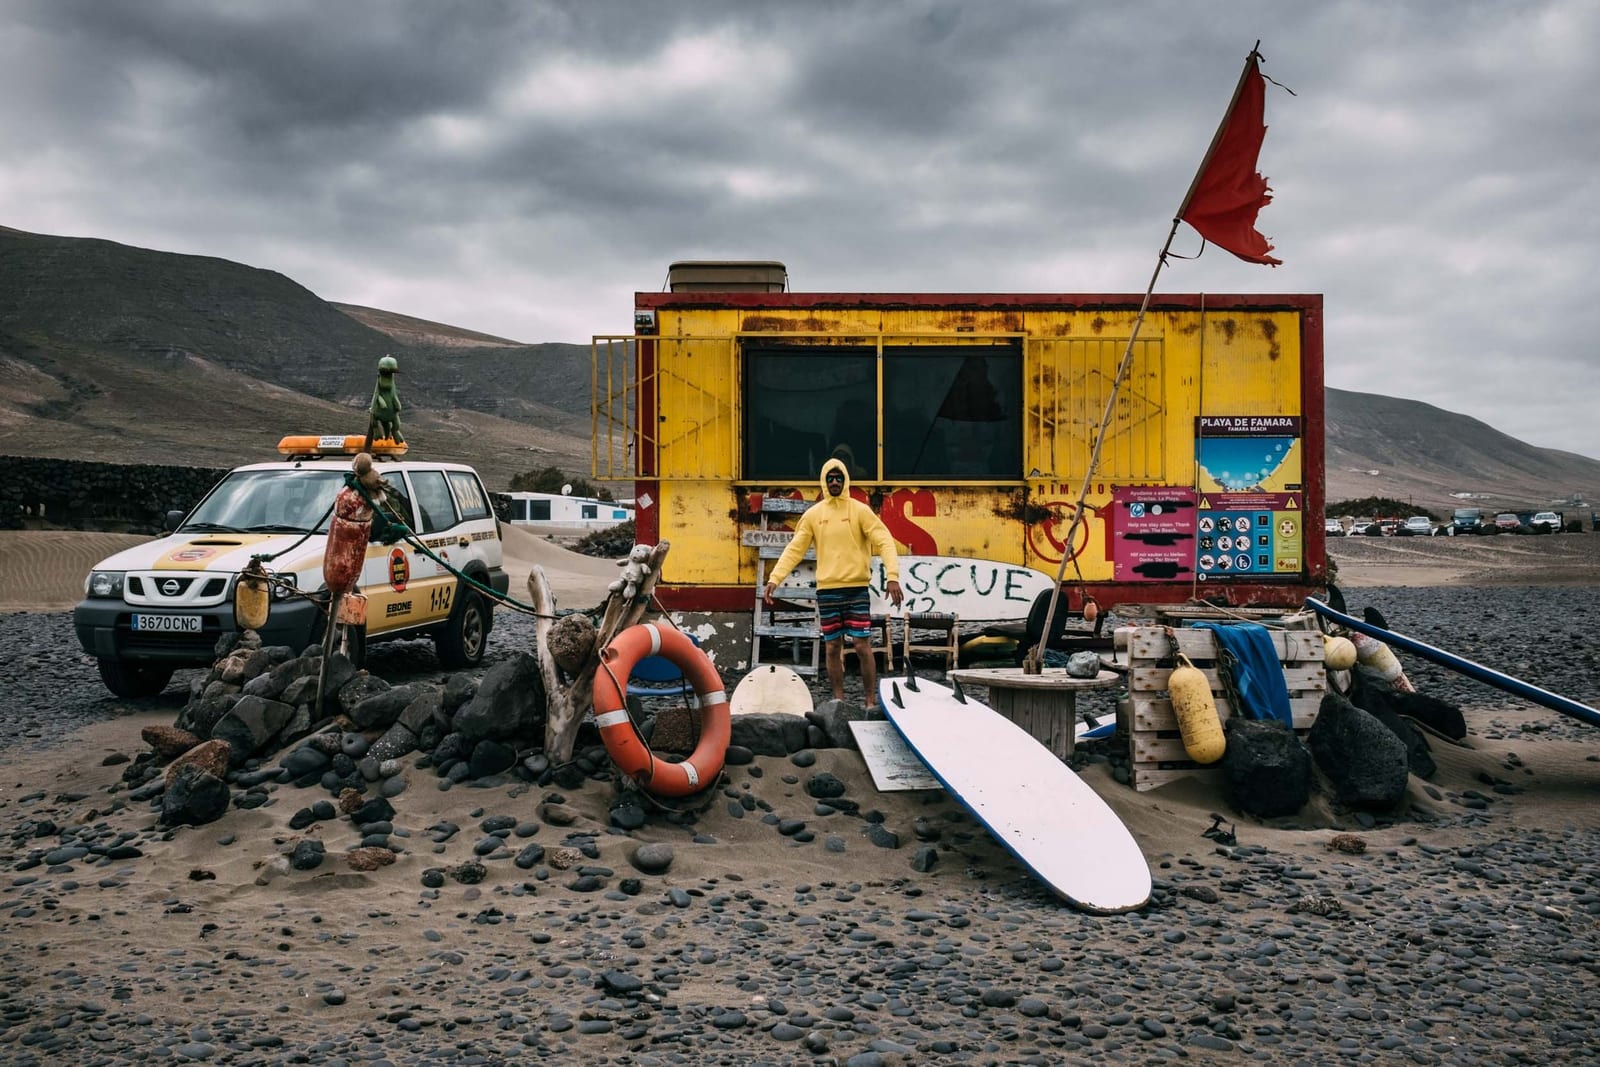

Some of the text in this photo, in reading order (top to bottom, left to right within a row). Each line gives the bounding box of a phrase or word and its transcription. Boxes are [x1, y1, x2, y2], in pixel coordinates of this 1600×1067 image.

[1201, 418, 1293, 427] PLAYA DE FAMARA
[386, 600, 413, 613] EBONE
